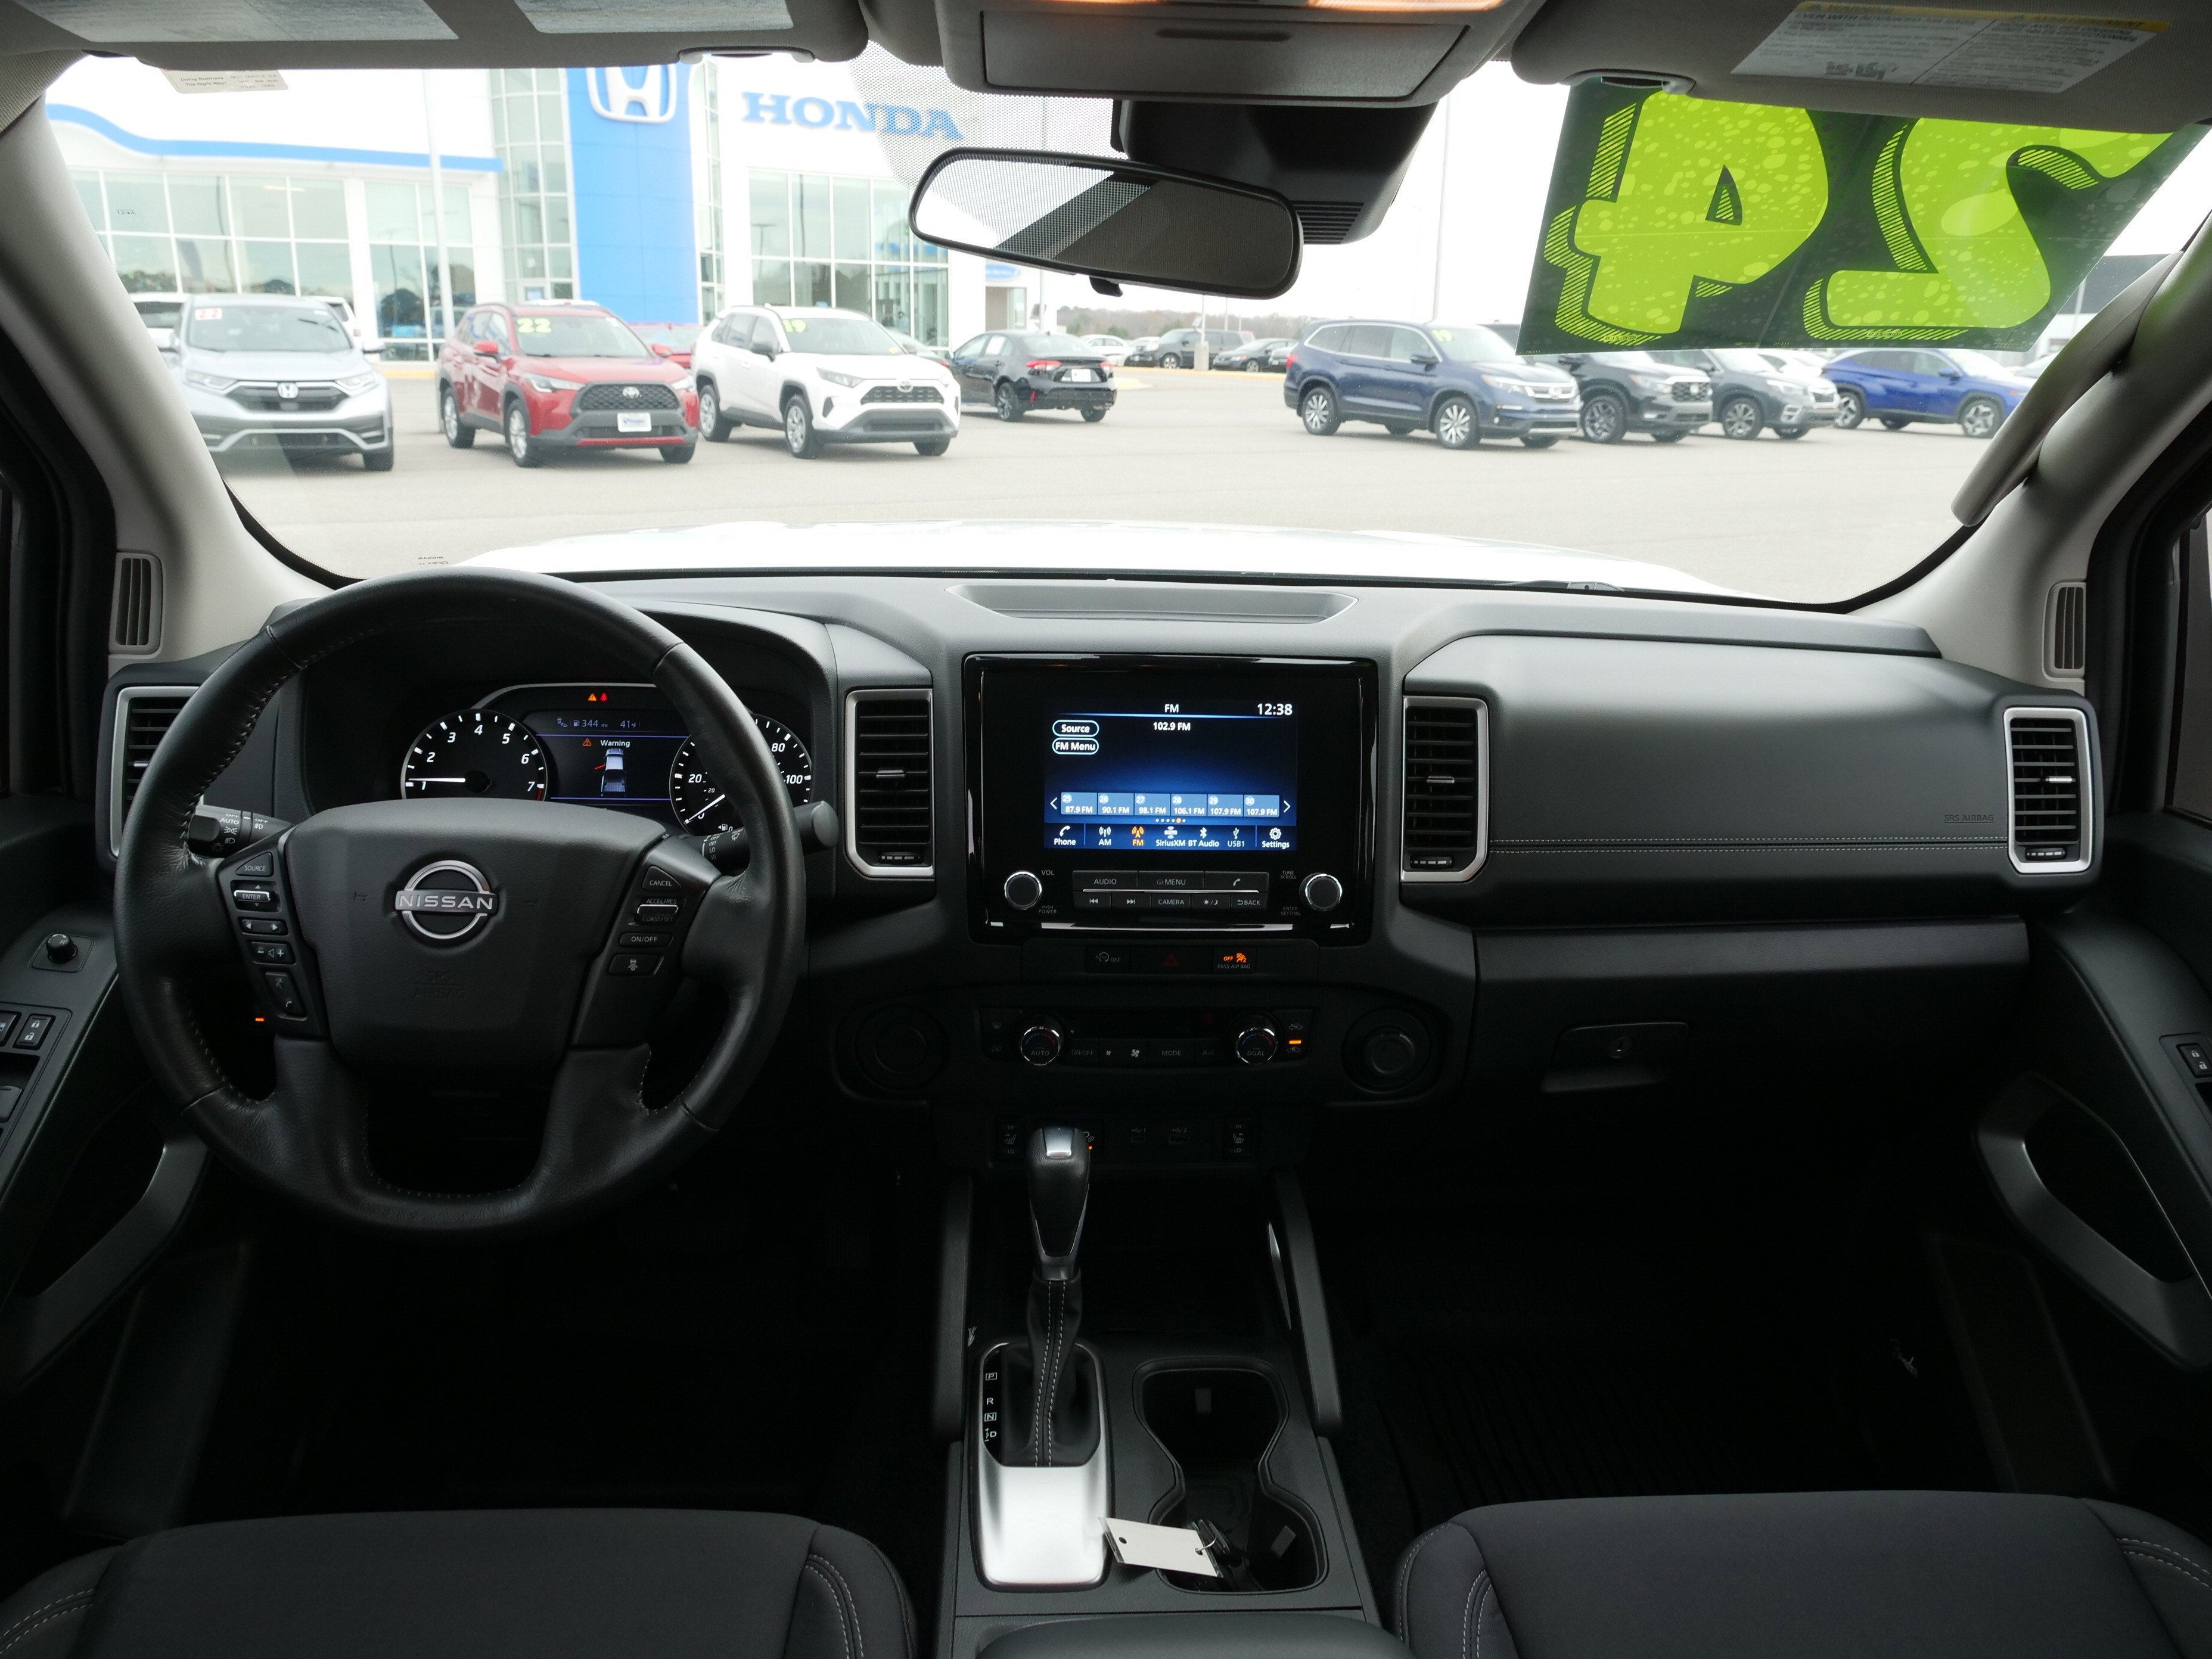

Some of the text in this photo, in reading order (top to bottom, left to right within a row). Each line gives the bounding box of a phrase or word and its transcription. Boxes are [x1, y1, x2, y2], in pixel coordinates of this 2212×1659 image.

[741, 91, 965, 140] HONDA
[517, 318, 552, 333] 22
[1164, 704, 1179, 713] FM
[1257, 703, 1293, 716] 12:38
[474, 725, 483, 735] 4
[1061, 724, 1090, 734] Source
[1153, 722, 1191, 731] 102.9 FM
[448, 732, 456, 742] 3
[502, 733, 511, 744] 5
[771, 742, 785, 753] 80
[1055, 742, 1096, 751] FM Menu
[426, 752, 436, 763] 2
[521, 754, 530, 764] 6
[688, 774, 702, 783] 20
[785, 775, 803, 784] 100
[527, 781, 535, 791] 7
[1262, 841, 1290, 849] Settings
[399, 894, 493, 910] NISSAN
